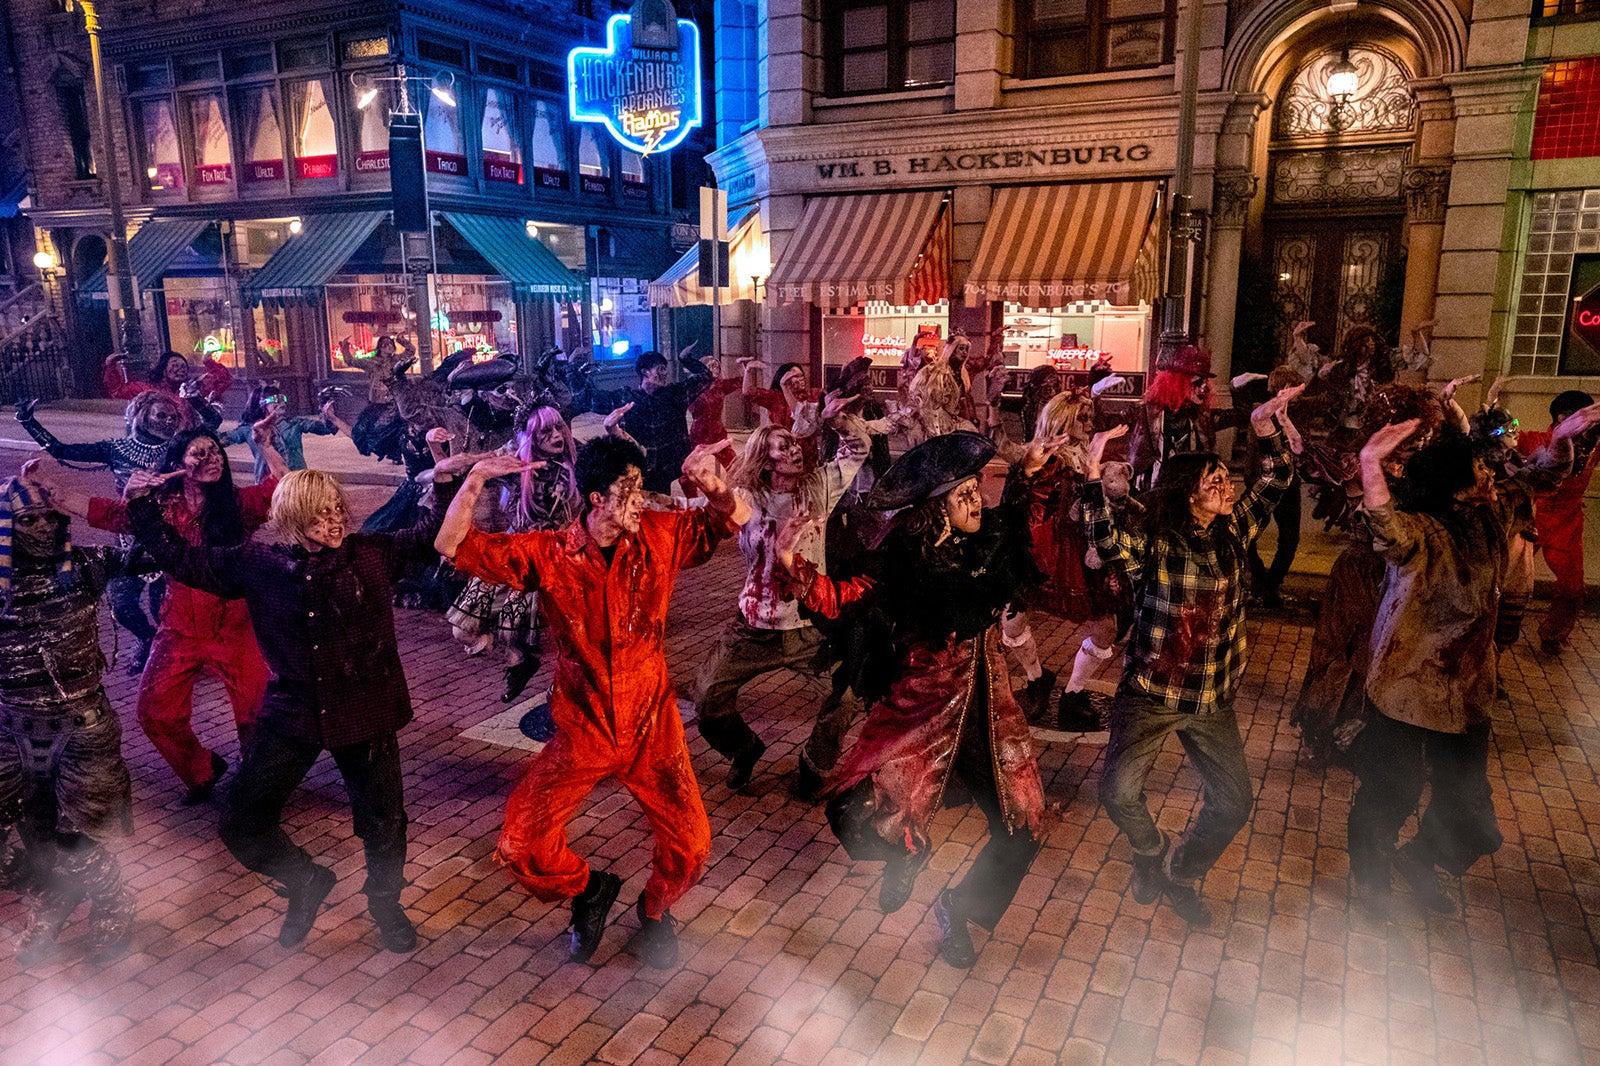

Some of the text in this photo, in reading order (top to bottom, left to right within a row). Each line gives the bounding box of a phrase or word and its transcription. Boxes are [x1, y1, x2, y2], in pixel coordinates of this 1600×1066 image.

[631, 48, 669, 61] WILLIAM
[582, 57, 686, 102] HACKENBURG
[613, 87, 686, 116] APPLIANCES
[437, 157, 458, 172] TANGO
[873, 159, 897, 176] B.
[908, 144, 1152, 174] HACKENBURG
[819, 284, 894, 298] ESTIMATES
[992, 283, 1099, 297] HACKENBURG'S
[861, 333, 907, 347] Electric
[871, 347, 897, 356] FANS
[1046, 348, 1100, 361] SWEEPERS
